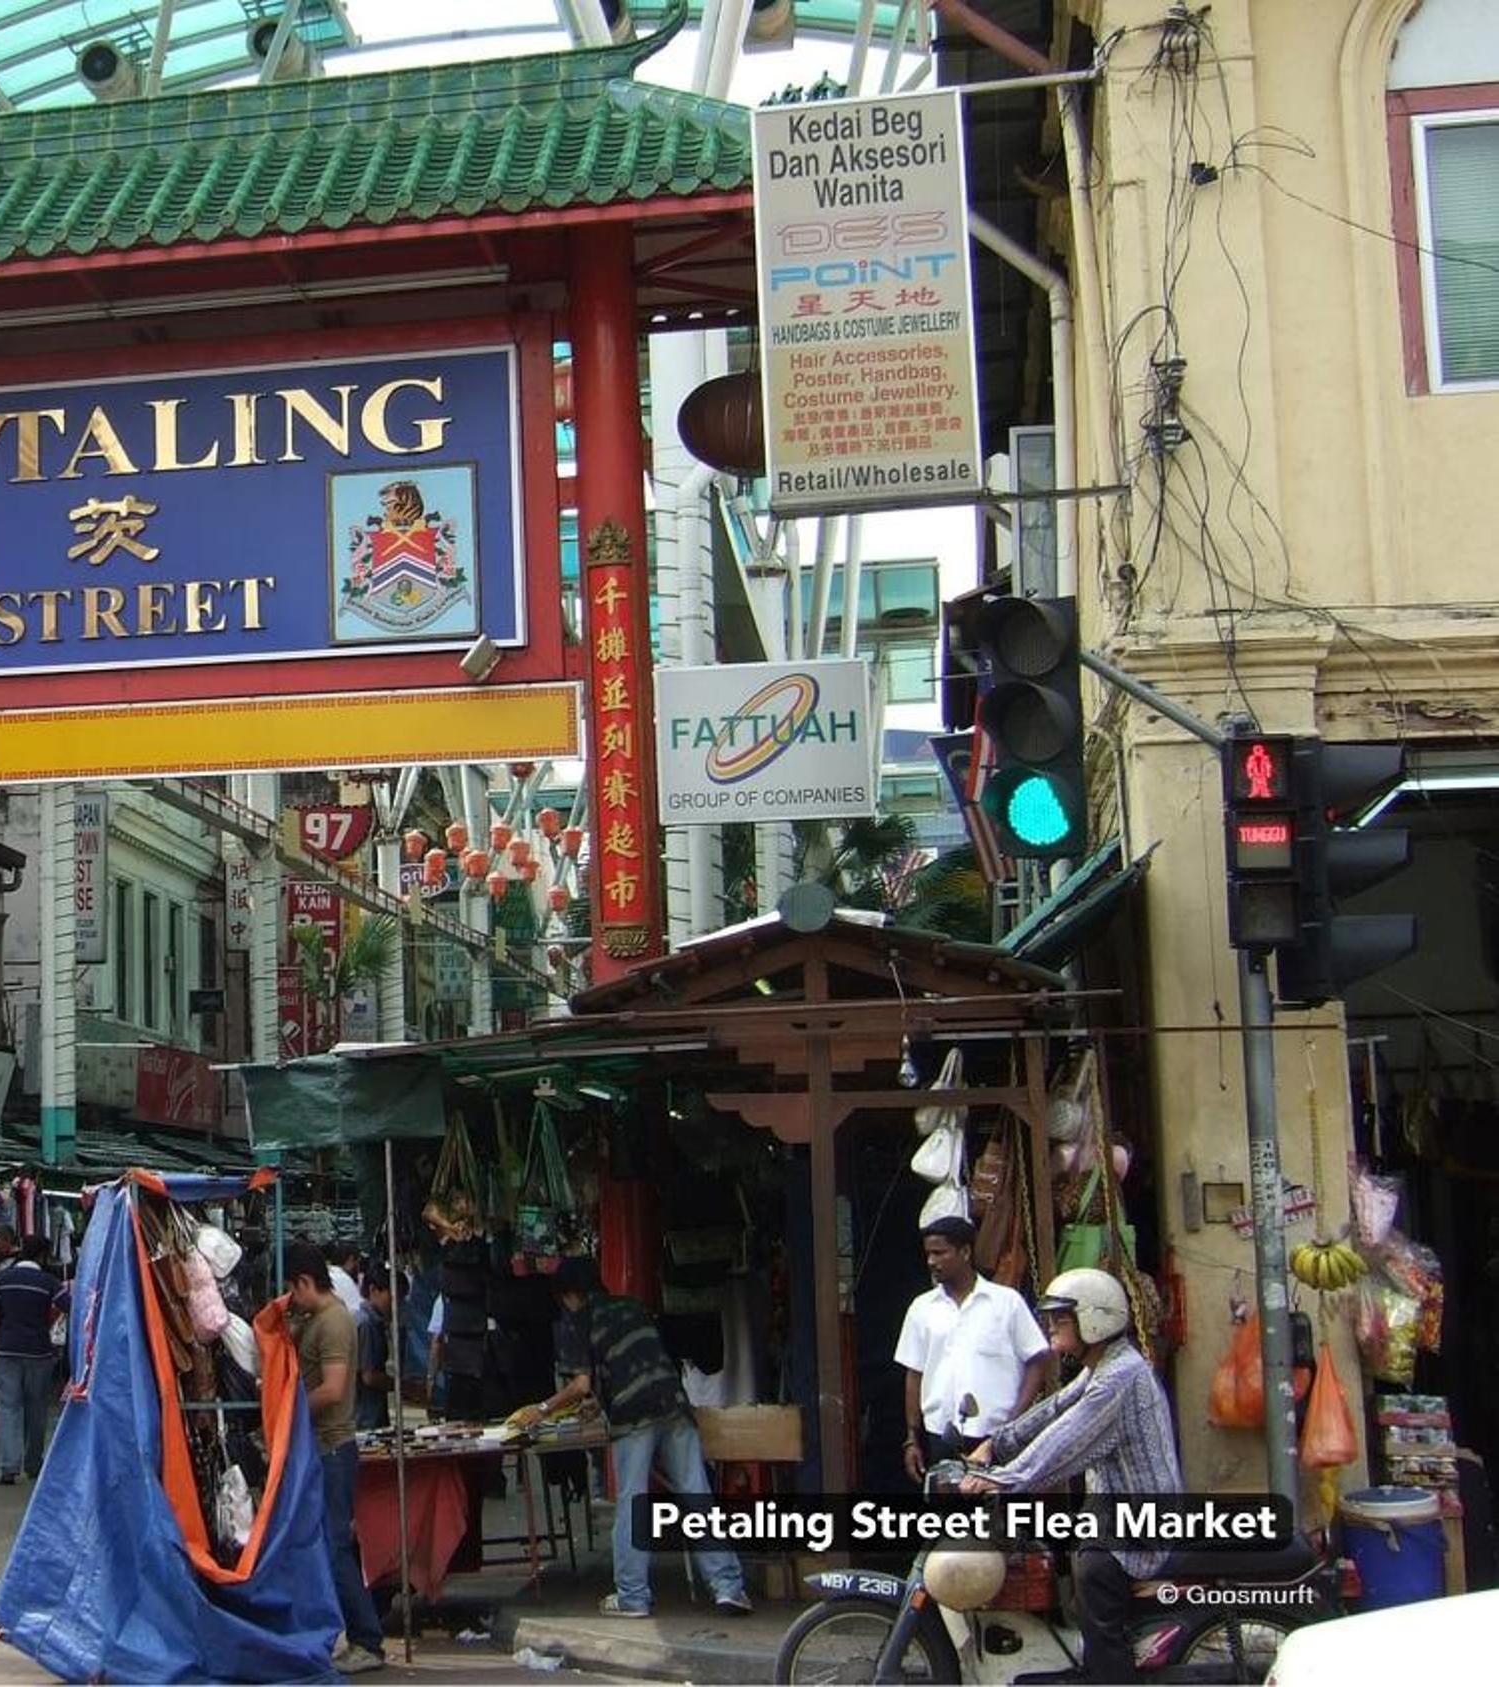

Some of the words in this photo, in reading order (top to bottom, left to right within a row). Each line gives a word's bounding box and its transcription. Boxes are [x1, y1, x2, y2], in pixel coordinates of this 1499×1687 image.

[789, 109, 861, 144] Kedai
[871, 106, 922, 140] Beg
[769, 149, 820, 179] Dan
[830, 133, 946, 175] Aksesori
[814, 174, 904, 208] Wanita
[772, 320, 830, 345] HANDBAGS
[842, 316, 895, 339] COSTUME
[898, 311, 960, 335] JEWELLERY
[790, 351, 826, 369] Hair
[784, 389, 864, 409] Costume
[778, 460, 970, 492] Retail/Wholesale
[671, 711, 857, 750] FATTUAH
[669, 792, 730, 811] GROUP
[735, 790, 758, 808] OF
[764, 786, 865, 806] COMPANIES
[305, 813, 352, 850] 97
[821, 1574, 854, 1590] WBY
